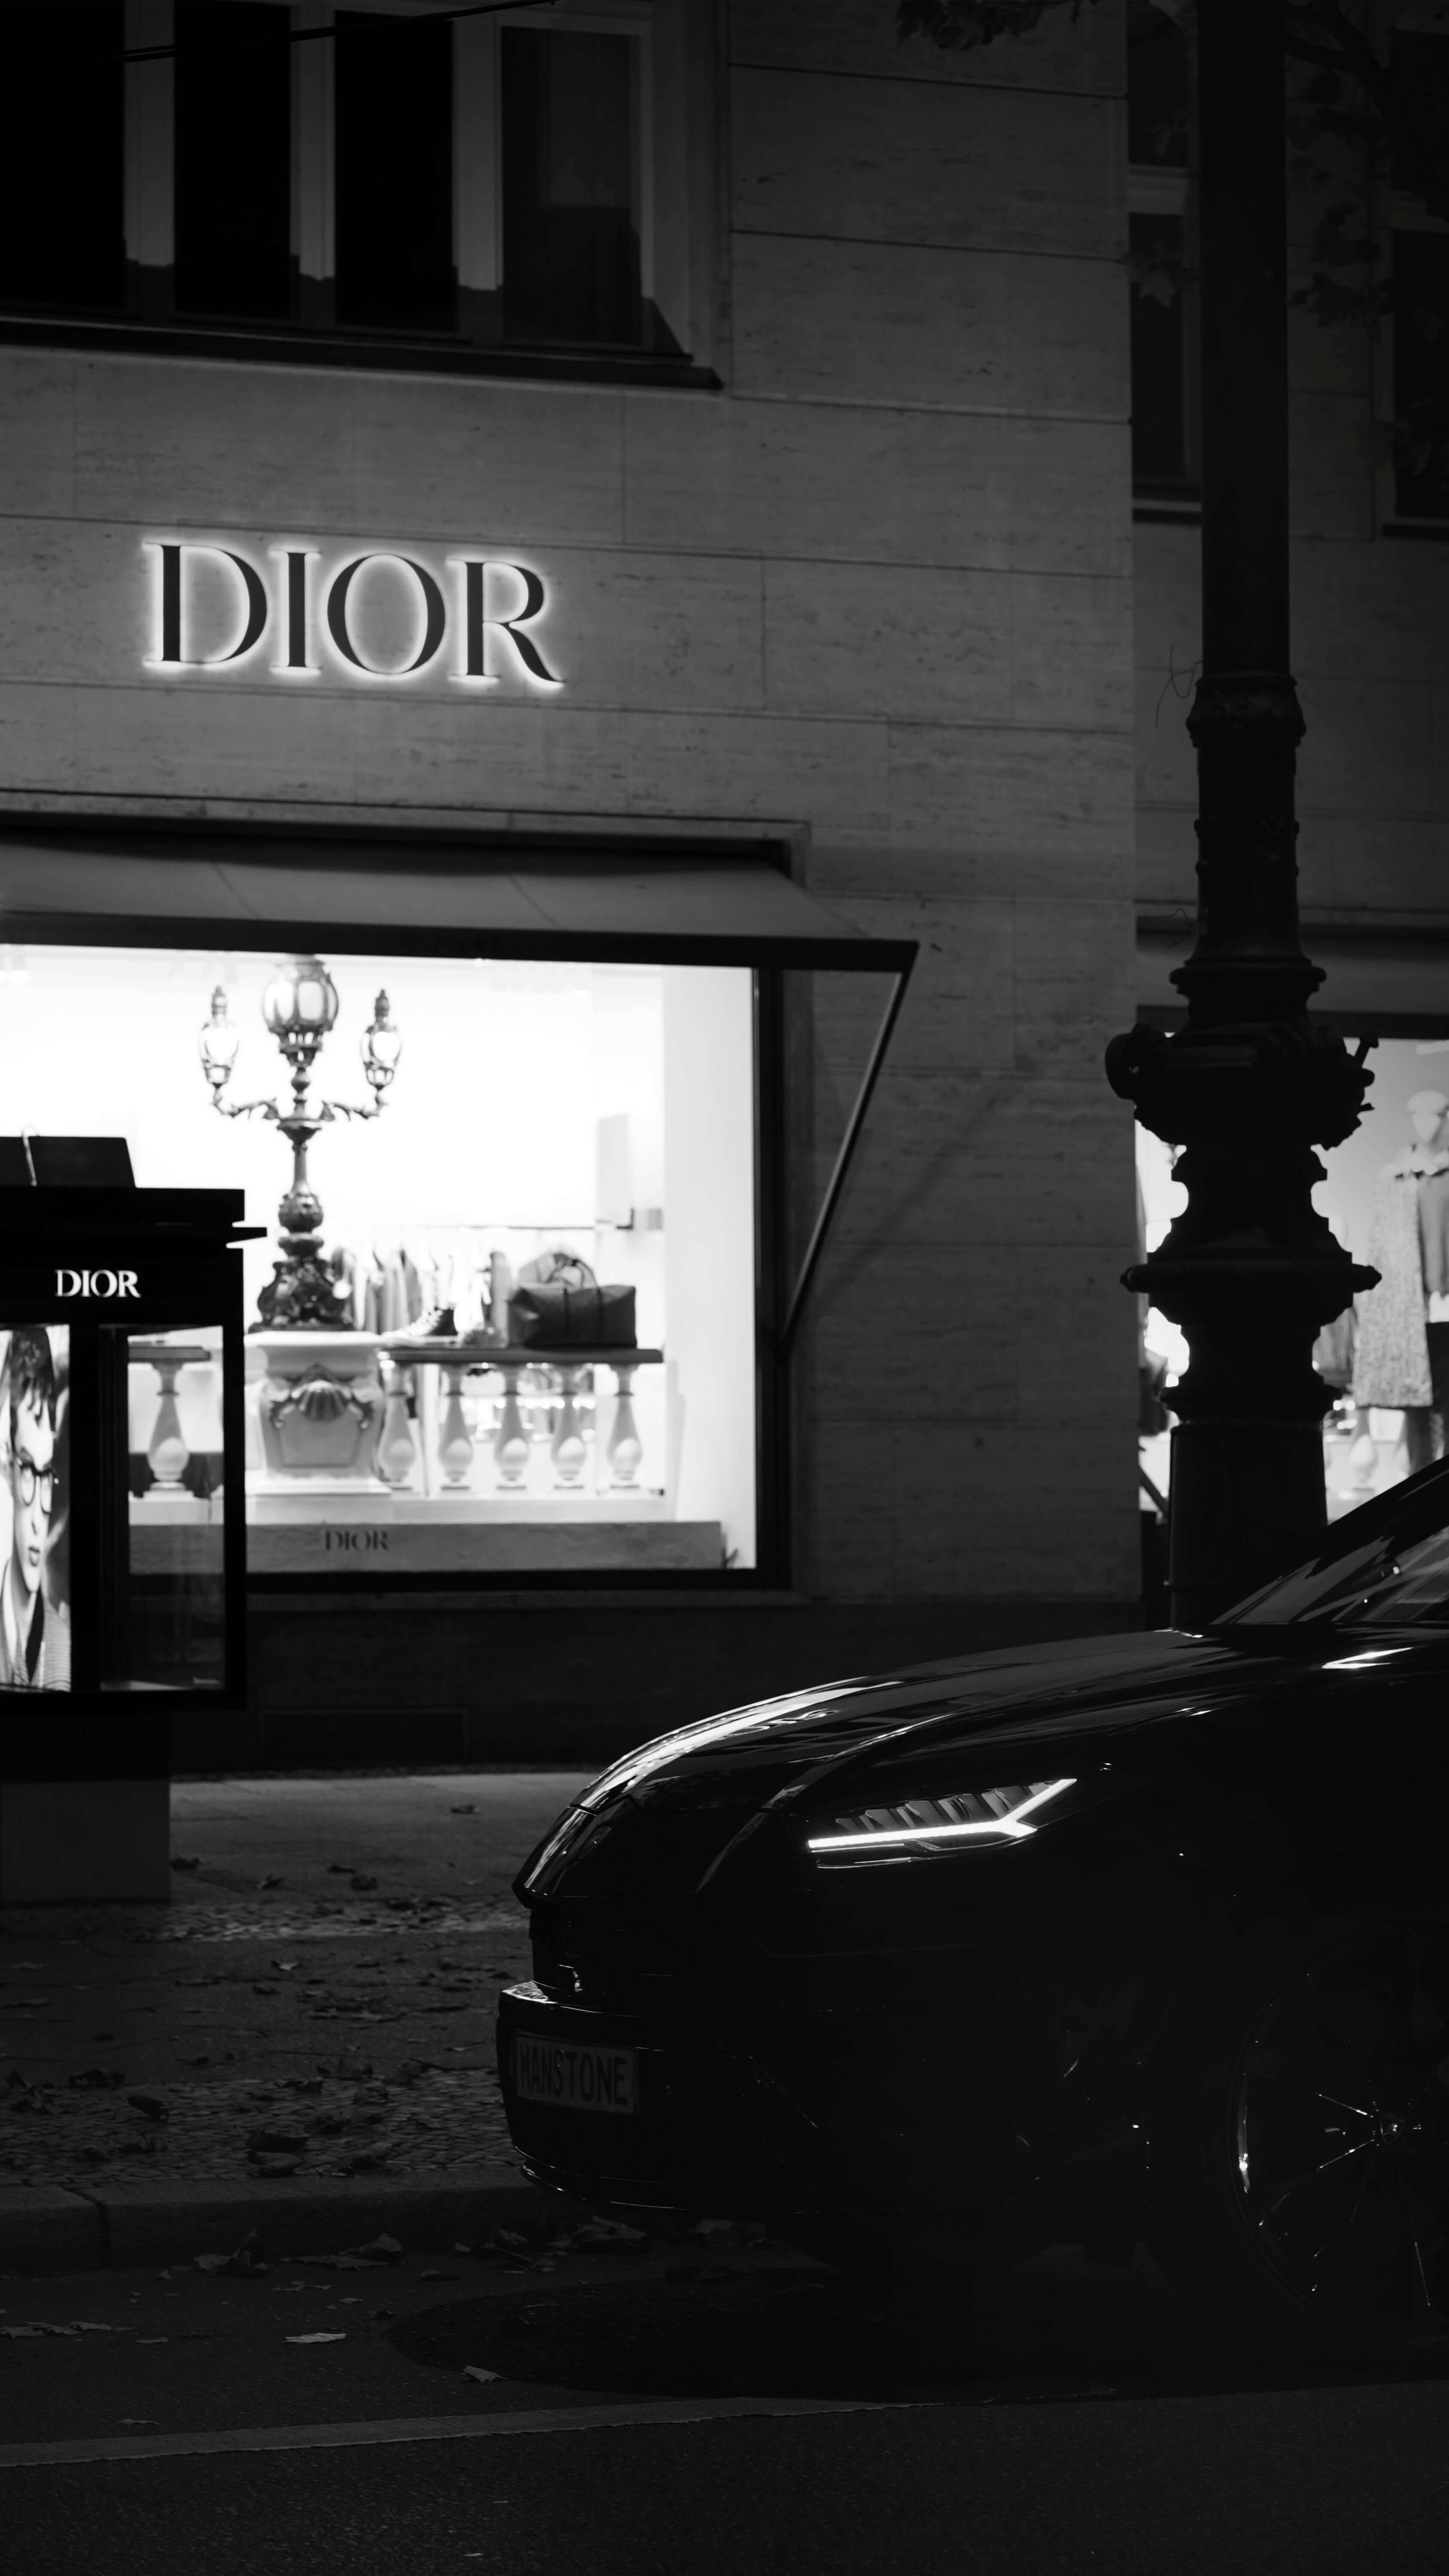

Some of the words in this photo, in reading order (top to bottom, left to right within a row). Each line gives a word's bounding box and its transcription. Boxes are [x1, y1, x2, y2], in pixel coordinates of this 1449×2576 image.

[144, 543, 565, 686] DIOR
[55, 1269, 142, 1298] DIOR
[325, 1530, 389, 1552] DIOR
[519, 2044, 628, 2105] MANSTONE
